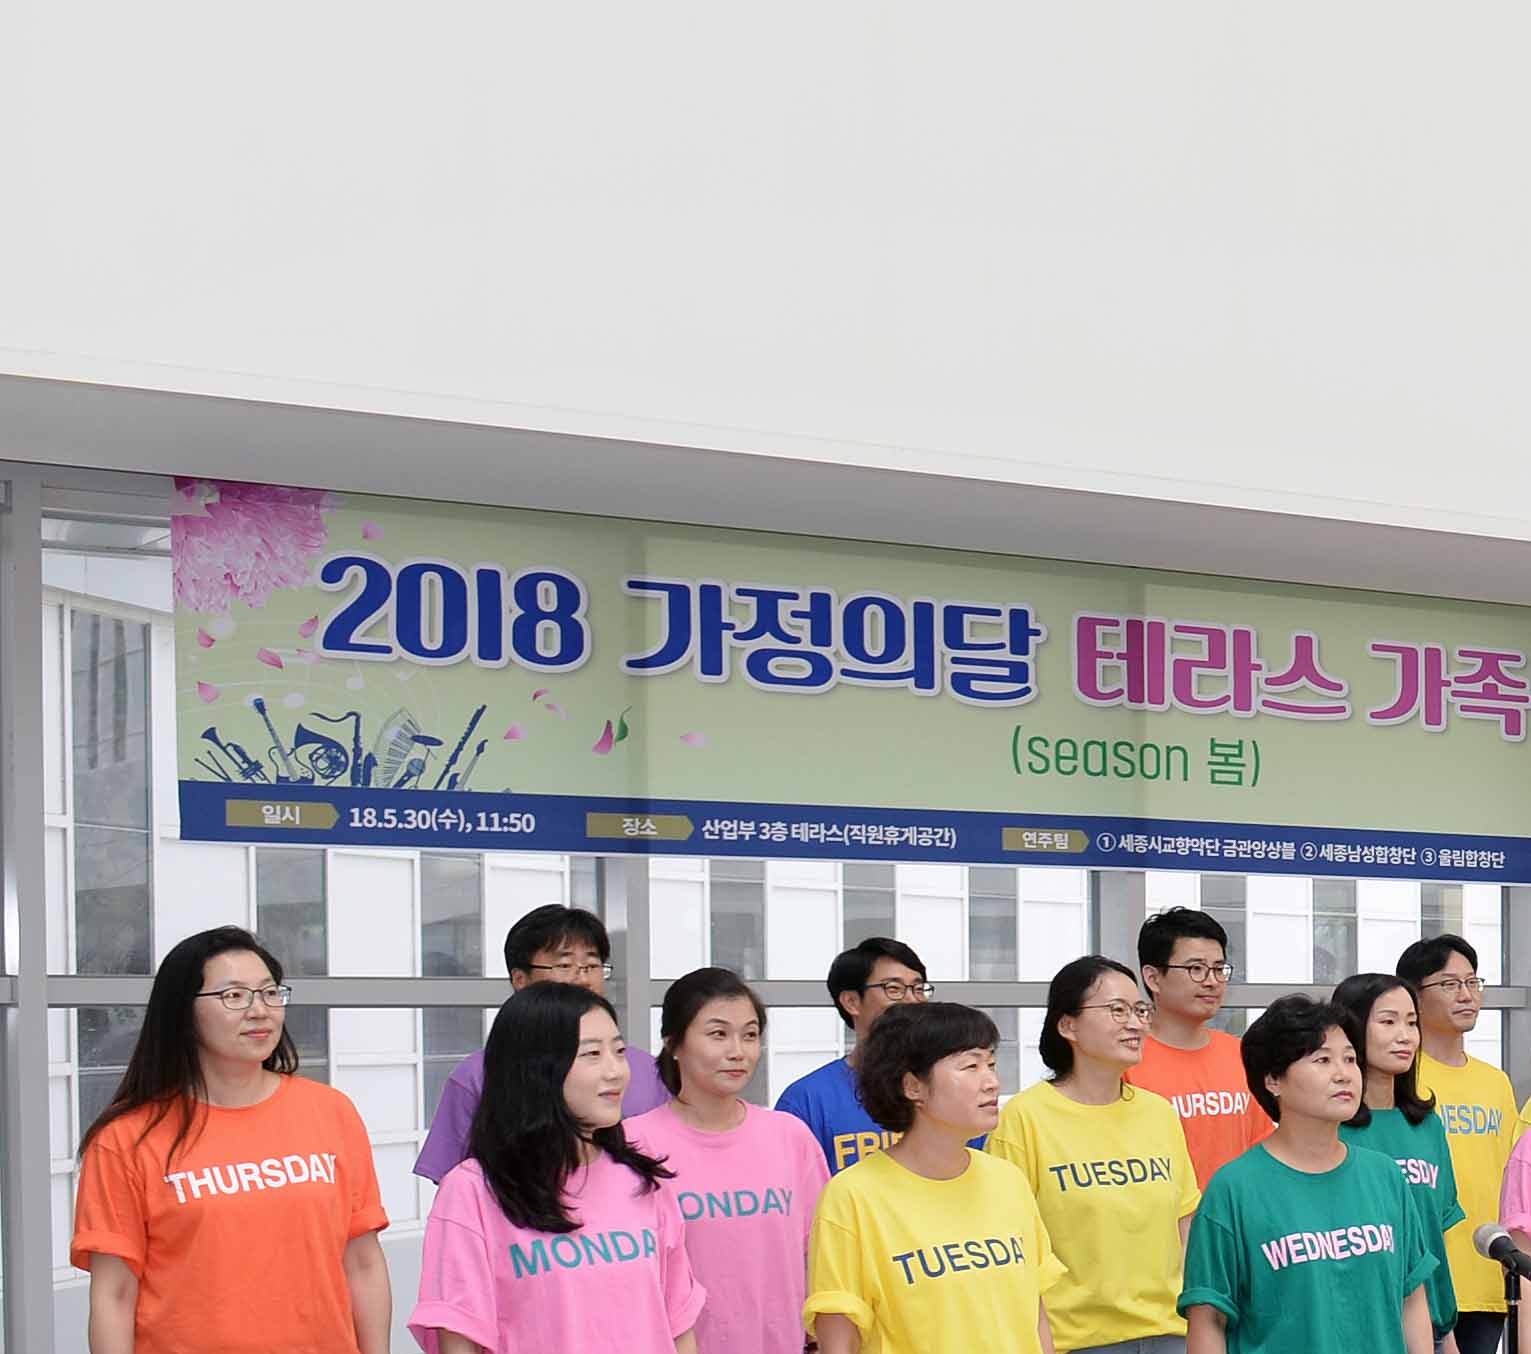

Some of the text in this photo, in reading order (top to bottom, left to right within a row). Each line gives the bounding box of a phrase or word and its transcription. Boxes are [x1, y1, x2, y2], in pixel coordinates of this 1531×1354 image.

[318, 554, 588, 671] 2018
[624, 578, 1043, 704] 가정의달
[1075, 614, 1349, 716] 테라스
[1012, 725, 1261, 787] (season 봄)
[261, 805, 536, 832] 일시 18.5.30(수), 11:50
[622, 817, 657, 836] 장소
[702, 819, 755, 841] 산업부
[759, 822, 789, 842] 3층
[1022, 832, 1069, 850] 연주팀
[1171, 1090, 1251, 1118] HURSDAY
[162, 1152, 337, 1204] THURSDAY
[1049, 1157, 1172, 1192] TUESDAY
[677, 1187, 792, 1221] ONDAY
[508, 1228, 657, 1279] MONDA
[892, 1236, 1025, 1285] TUESDA
